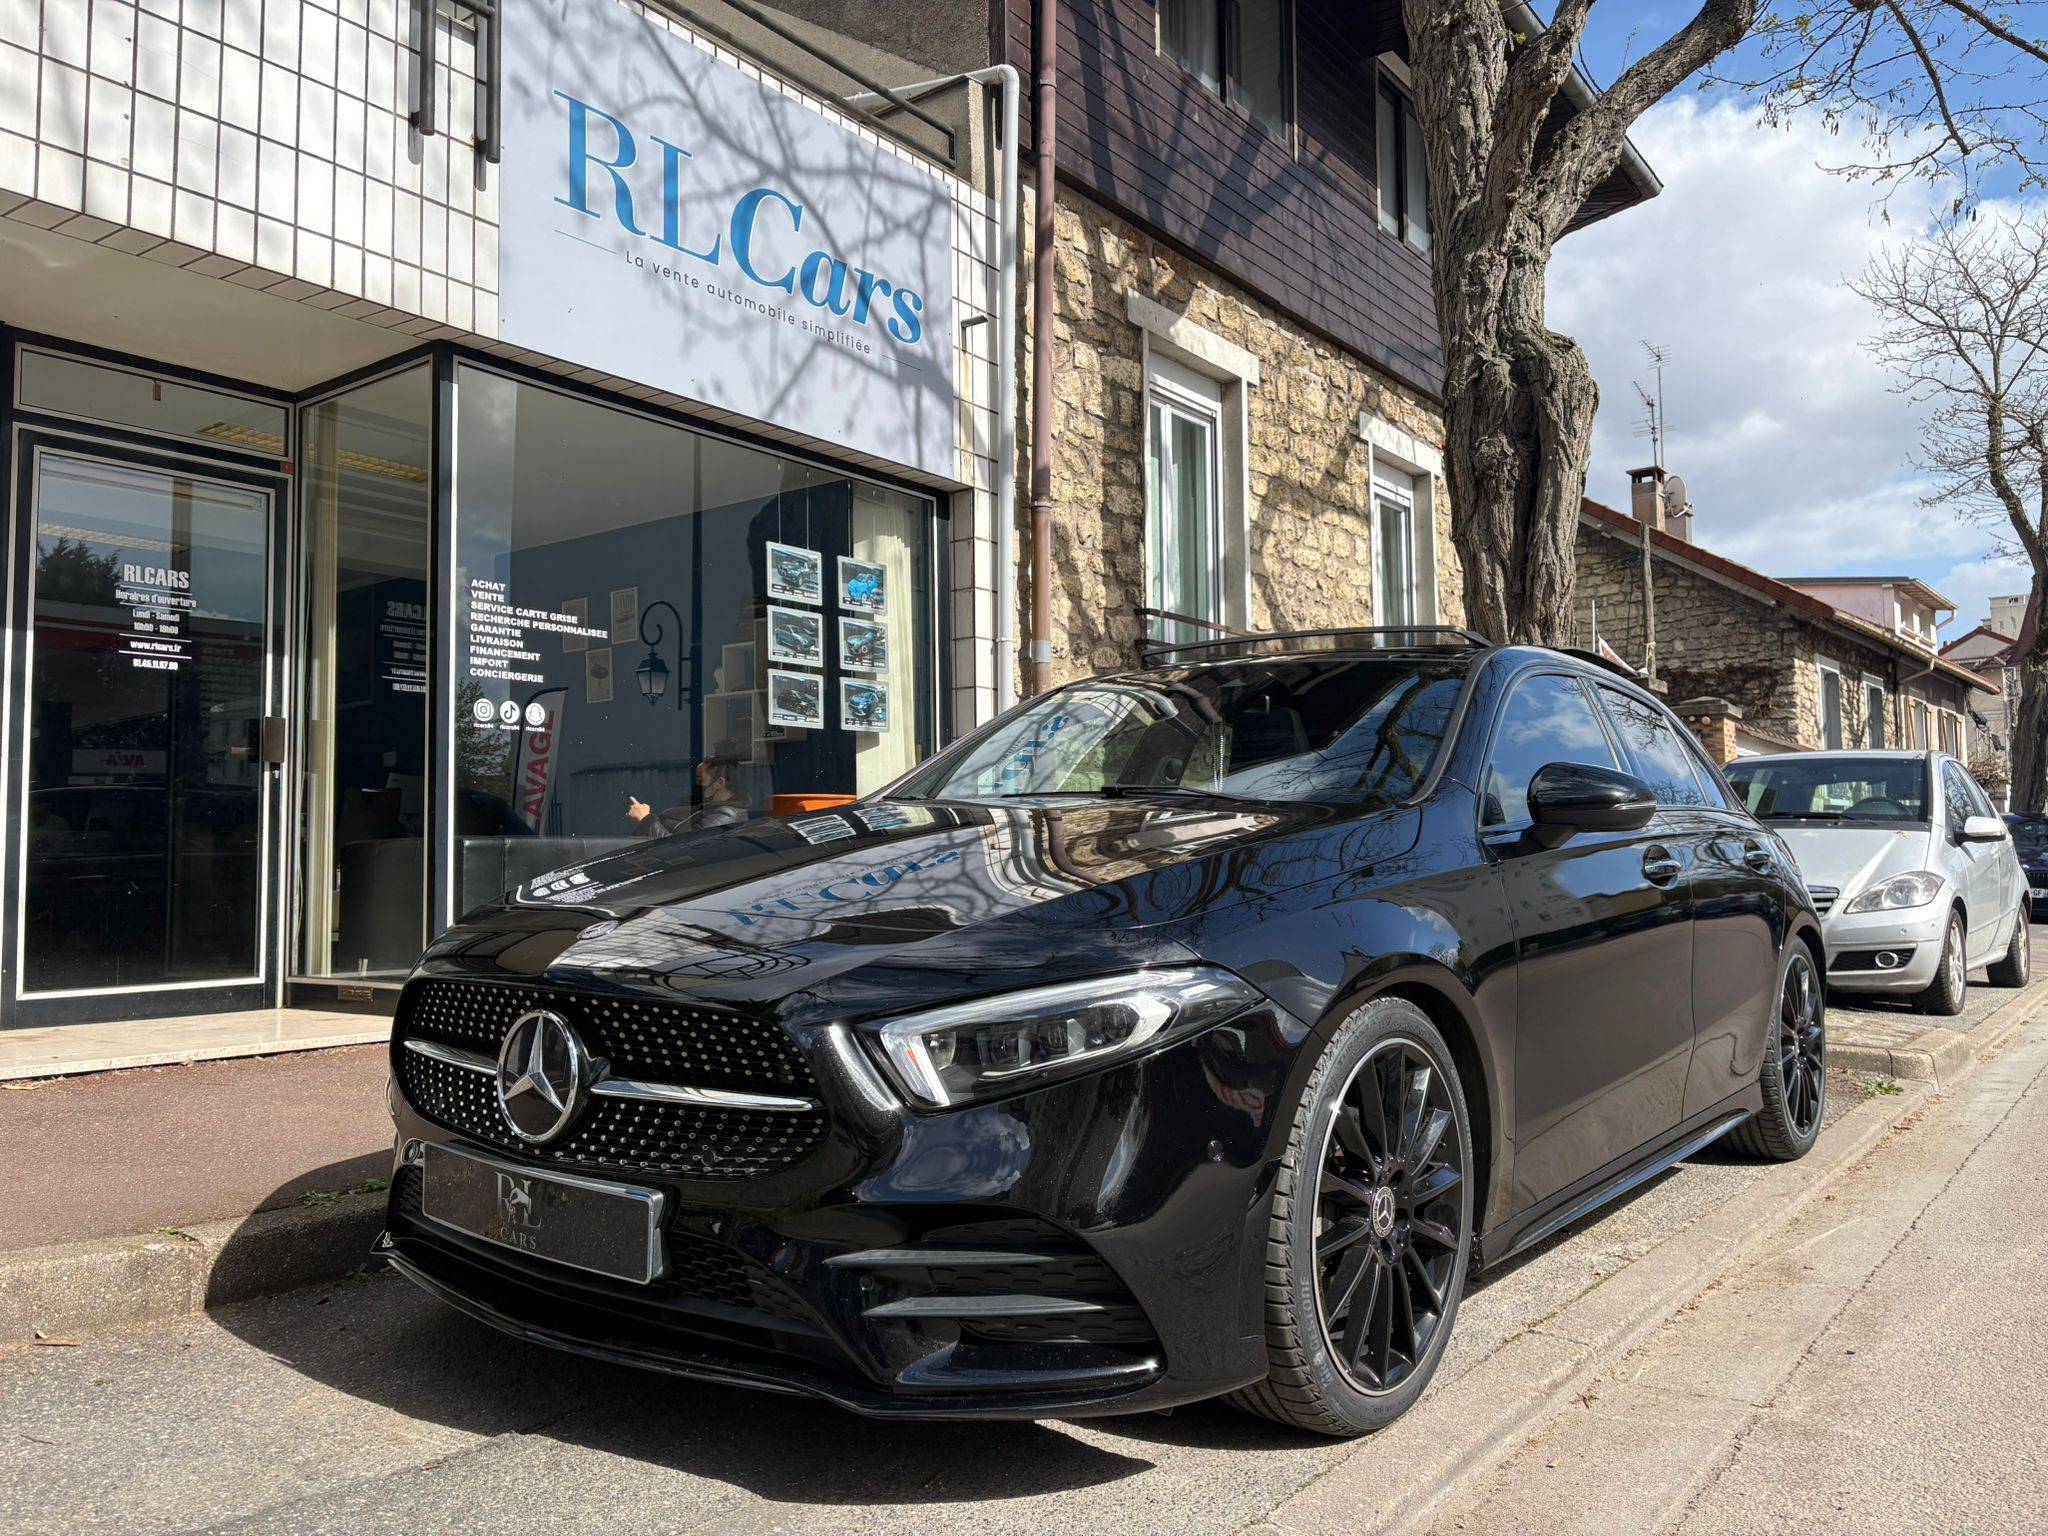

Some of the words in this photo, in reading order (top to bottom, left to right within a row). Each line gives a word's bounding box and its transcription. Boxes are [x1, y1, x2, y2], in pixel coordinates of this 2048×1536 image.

[553, 89, 924, 346] RLCars
[626, 250, 644, 268] La
[652, 262, 699, 289] vente
[706, 283, 796, 325] automobile
[802, 319, 871, 354] simplifiée
[123, 564, 190, 589] RLCARS
[471, 579, 506, 592] ACHAT
[115, 589, 150, 603] Horaires
[151, 592, 197, 608] d'ouverture
[471, 590, 505, 602] VENTE
[132, 609, 151, 619] Lundi
[156, 611, 180, 622] Samedi
[470, 601, 514, 615] SERVICE
[516, 608, 548, 620] CARTE
[550, 612, 578, 624] GRISE
[470, 612, 531, 628] RECHERCHE
[532, 621, 609, 639] PERSONNALISEE
[470, 623, 522, 638] GARANTIE
[130, 641, 182, 653] www.rlcars.fr
[470, 634, 524, 649] LIVRAISON
[470, 645, 541, 662] FINANCEMENT
[470, 657, 509, 668] IMPORT
[470, 668, 544, 683] CONCIERGERIE
[500, 1226, 537, 1250] CARS
